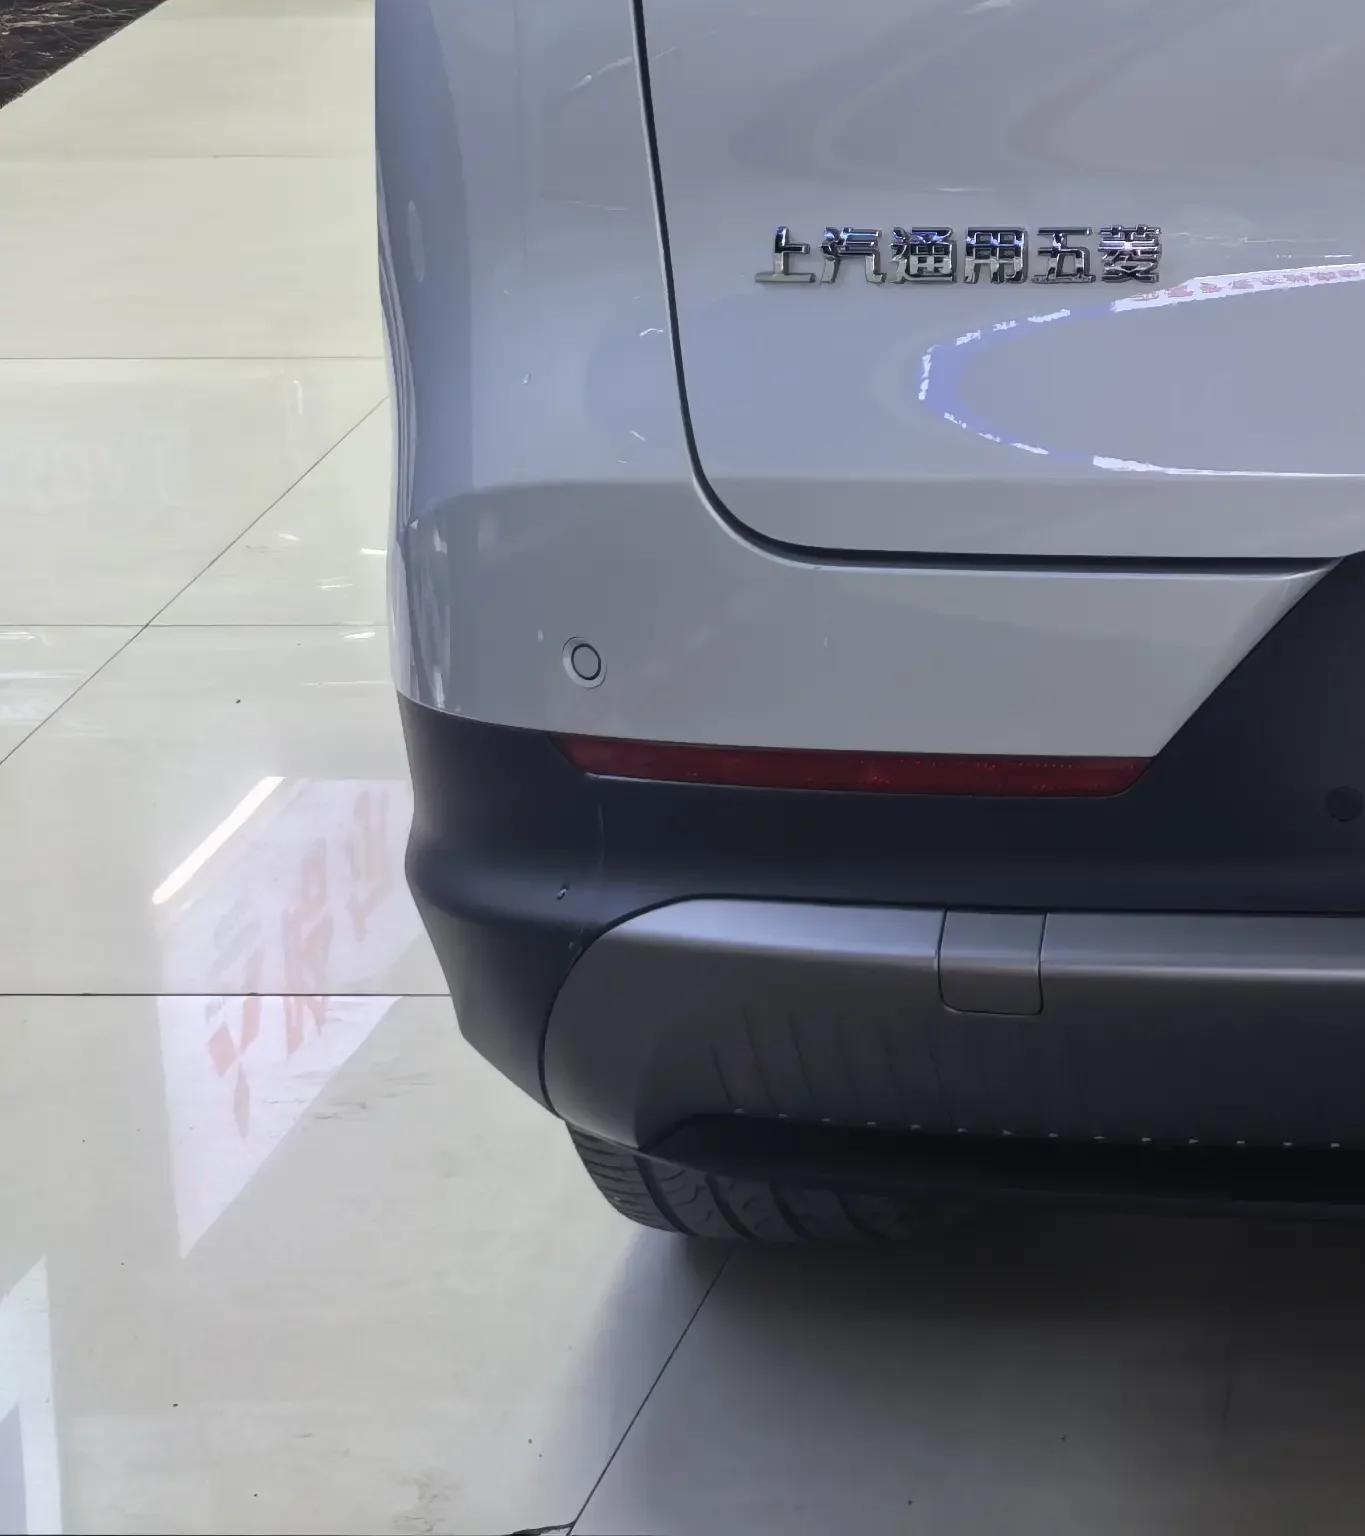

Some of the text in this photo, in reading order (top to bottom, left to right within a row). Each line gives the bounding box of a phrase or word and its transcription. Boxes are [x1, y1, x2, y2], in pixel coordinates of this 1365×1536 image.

[755, 226, 1162, 284] 上汽通用五菱
